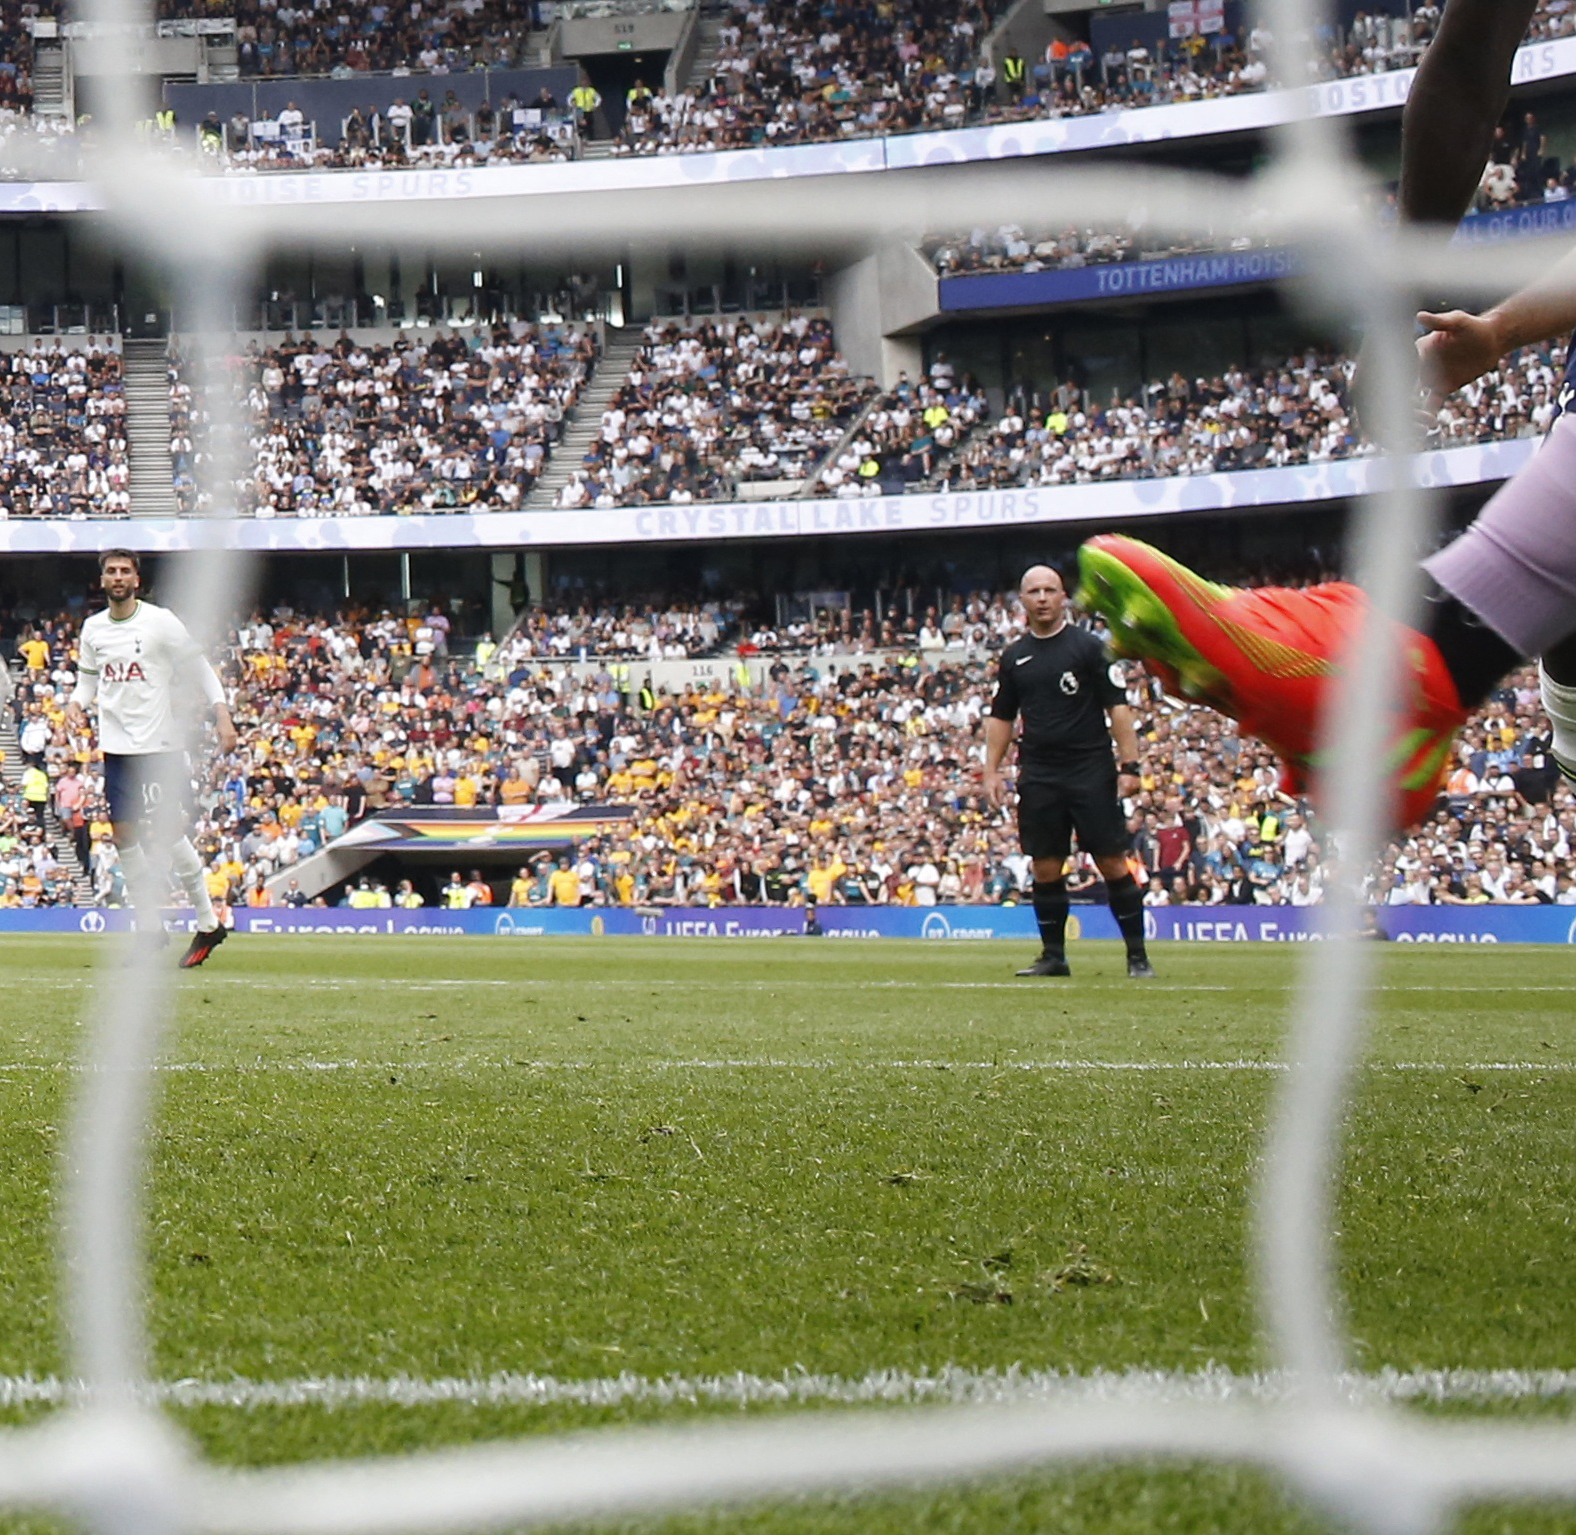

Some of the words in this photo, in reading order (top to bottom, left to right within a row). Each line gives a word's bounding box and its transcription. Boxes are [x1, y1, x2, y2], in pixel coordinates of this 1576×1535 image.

[1306, 74, 1412, 113] BOSTO
[352, 171, 474, 200] SPURS
[1096, 259, 1230, 292] TOTTENHAM
[635, 506, 795, 537] CRYSTAL
[813, 499, 904, 531] LAKE
[929, 492, 1041, 524] SPURS
[102, 661, 146, 682] AIA
